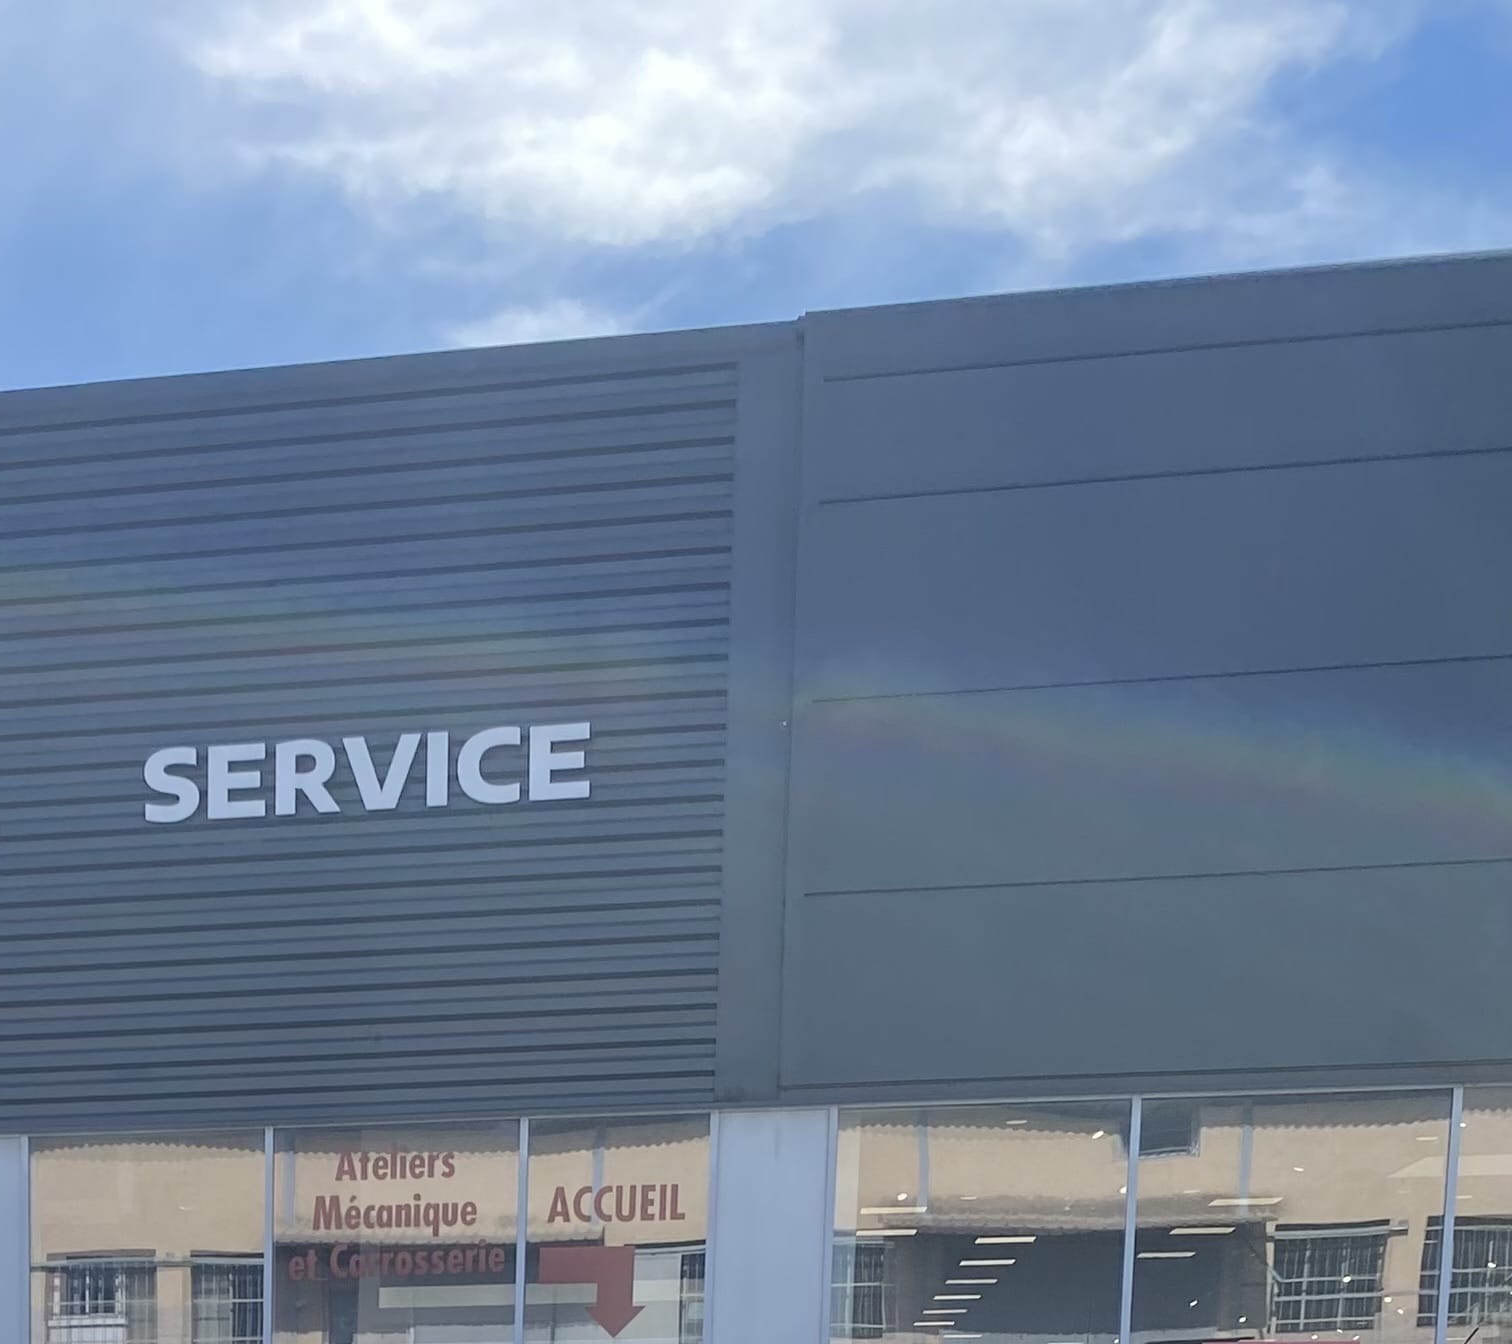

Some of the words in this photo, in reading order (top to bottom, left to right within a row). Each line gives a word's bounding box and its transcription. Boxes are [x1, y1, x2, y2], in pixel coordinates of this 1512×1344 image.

[143, 721, 591, 824] SERVICE
[335, 1150, 456, 1182] Ateliers
[311, 1194, 478, 1237] Mécanique
[548, 1183, 687, 1225] ACCUEIL
[288, 1251, 318, 1281] et
[330, 1240, 505, 1278] Carrosserie
